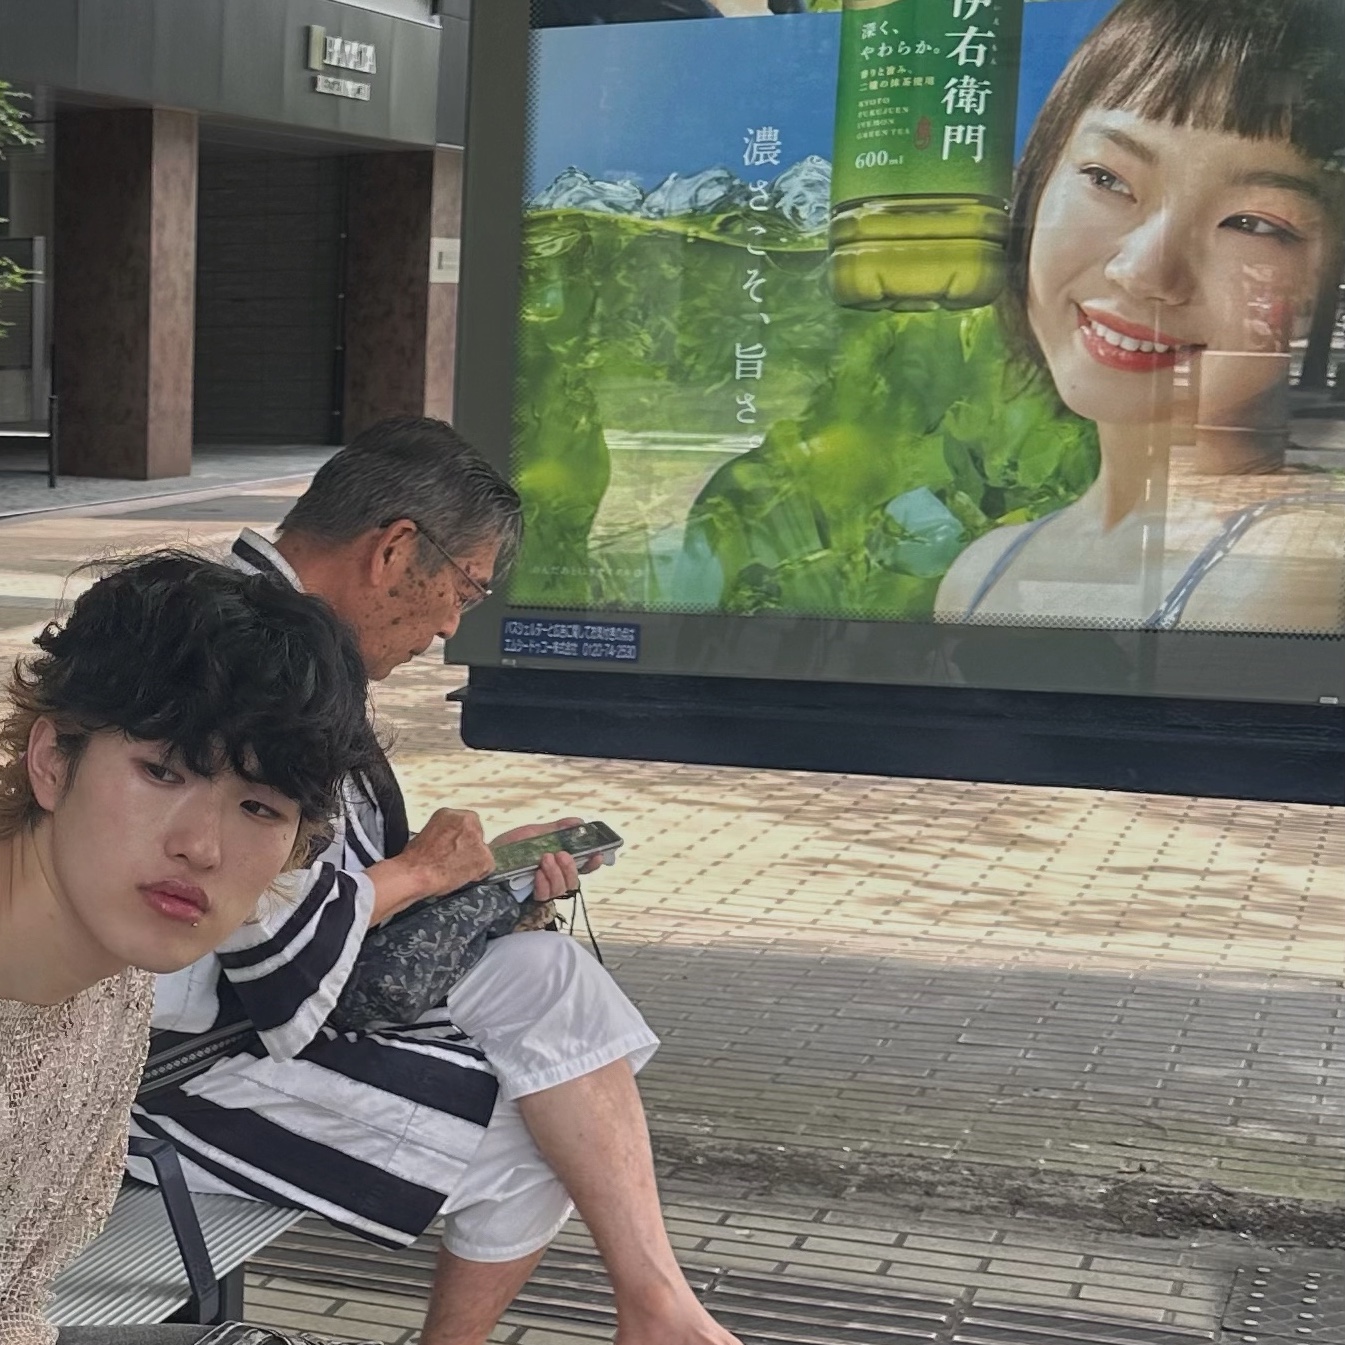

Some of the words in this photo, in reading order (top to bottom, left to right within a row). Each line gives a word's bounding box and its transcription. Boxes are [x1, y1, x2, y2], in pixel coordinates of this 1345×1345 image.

[861, 20, 899, 40] 深く、
[860, 40, 941, 60] やわらか。
[858, 97, 890, 107] KYOTO
[856, 129, 888, 140] GREEN
[890, 127, 910, 136] TEA
[855, 150, 904, 169] 600ml
